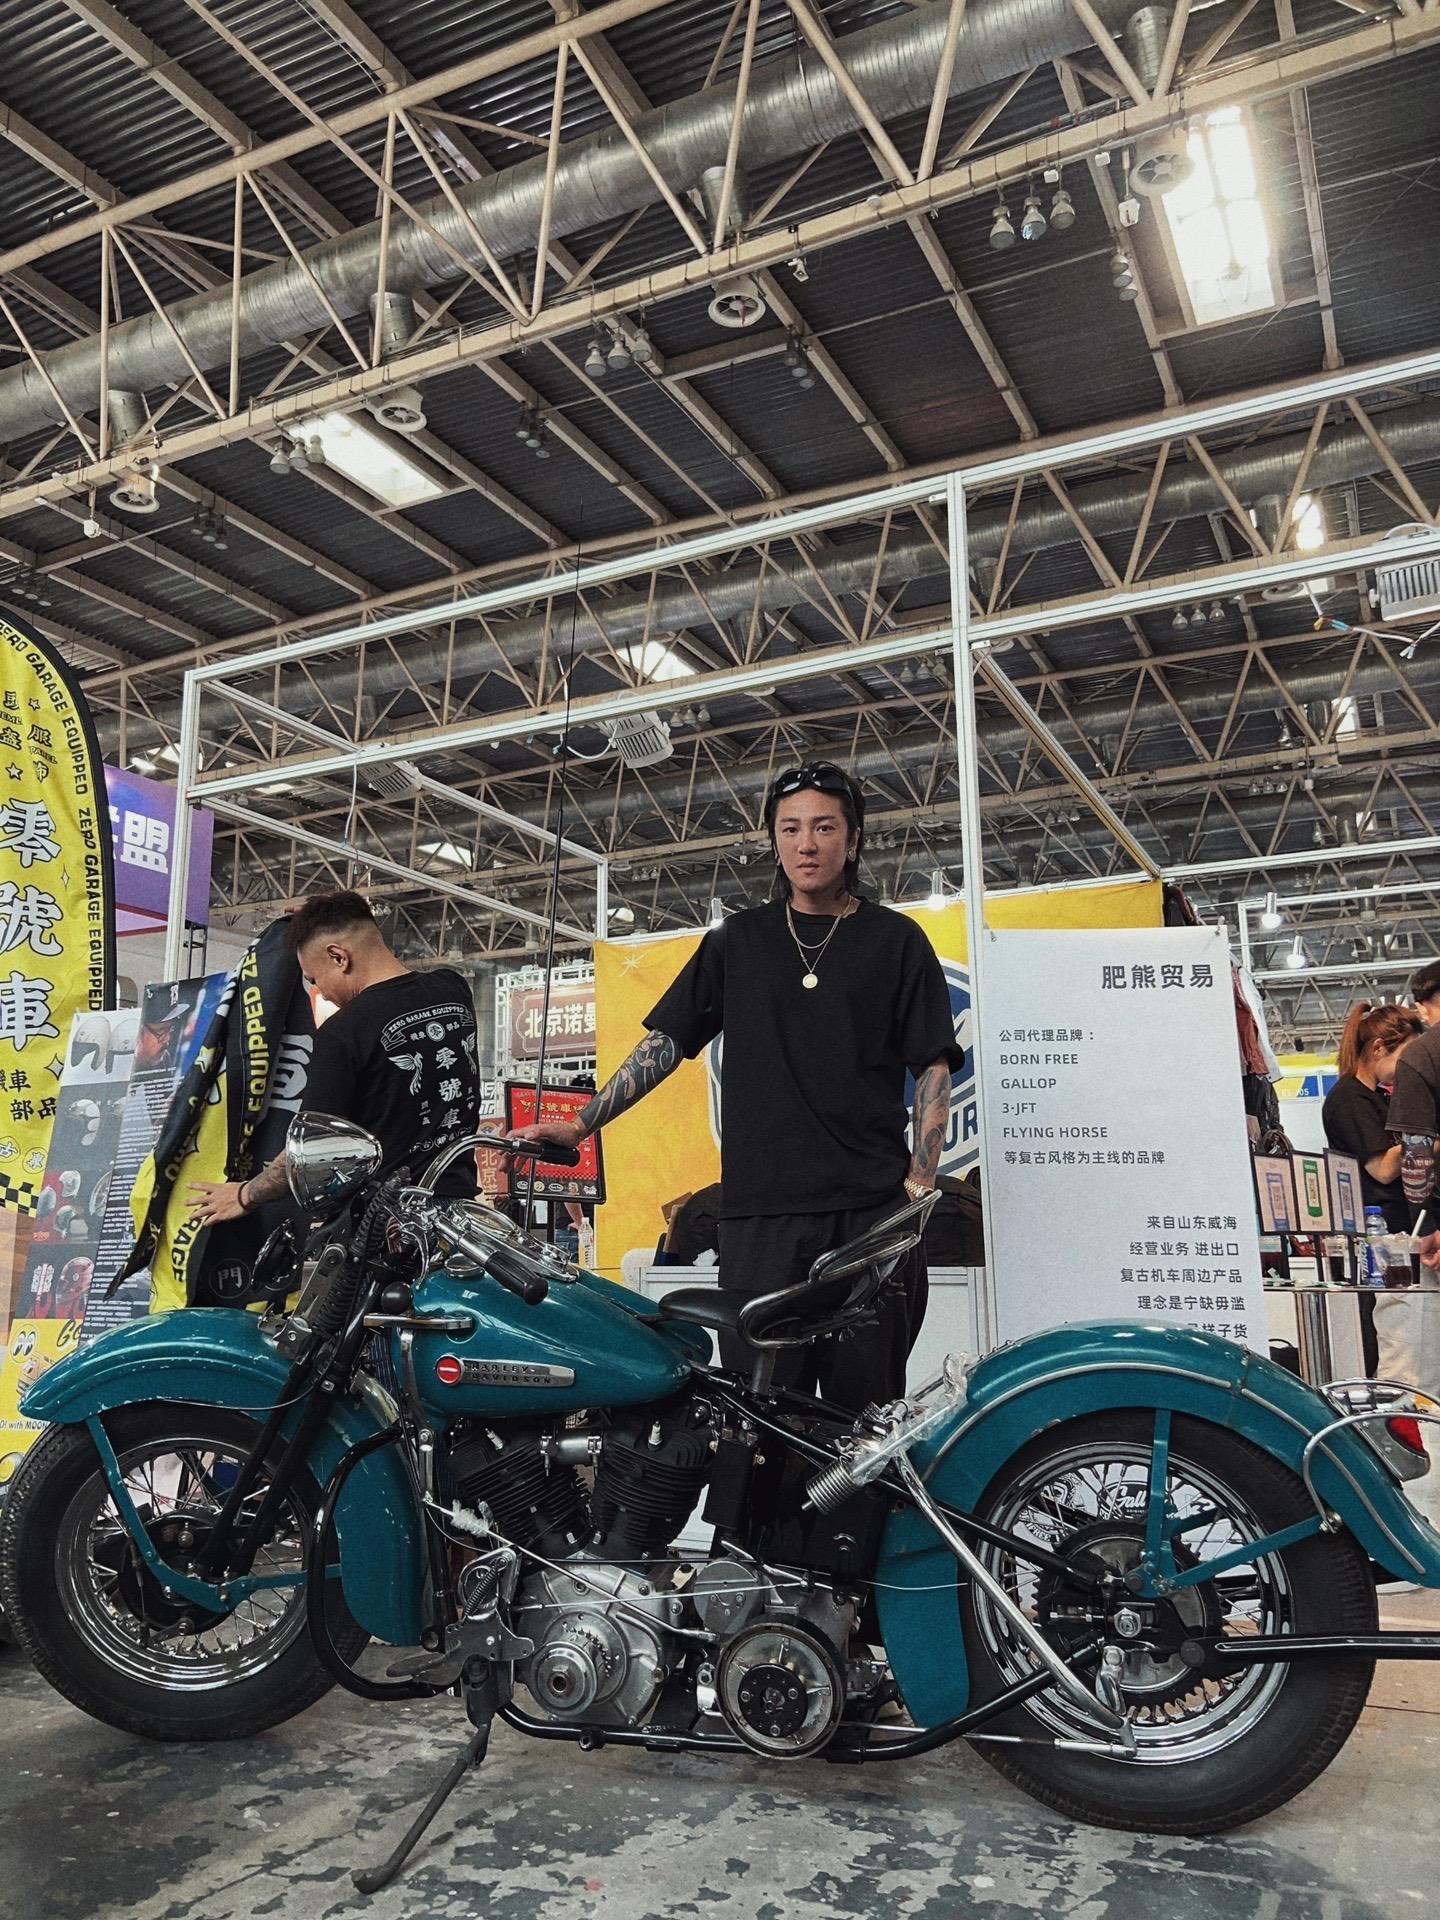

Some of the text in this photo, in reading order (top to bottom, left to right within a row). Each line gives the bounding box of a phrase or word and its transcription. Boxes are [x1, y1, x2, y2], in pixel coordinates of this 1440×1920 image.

[26, 652, 69, 713] GARAGE
[62, 716, 89, 796] EQUIPPED
[110, 809, 170, 875] 盟
[79, 807, 104, 1012] ZERO GARAGE EQUIPPED
[1101, 963, 1214, 990] 肥熊贸易
[999, 1027, 1095, 1043] 公司代理品牌：
[1000, 1053, 1079, 1066] BORN FREE
[1001, 1077, 1057, 1090] GALLOP
[11, 1096, 58, 1122] 部品
[1003, 1126, 1108, 1139] FLYING HORSE
[1004, 1150, 1166, 1166] 等复古风格为主线的品牌
[1146, 1214, 1238, 1231] 来自山东威海
[1130, 1241, 1240, 1257] 经营业务 进出口
[1120, 1268, 1243, 1284] 复古机车周边产品
[1137, 1295, 1246, 1312] 理念是宁缺毋滥
[471, 1373, 551, 1384] DAVIDSON
[9, 1420, 23, 1430] with
[1105, 1485, 1147, 1509] Gall
